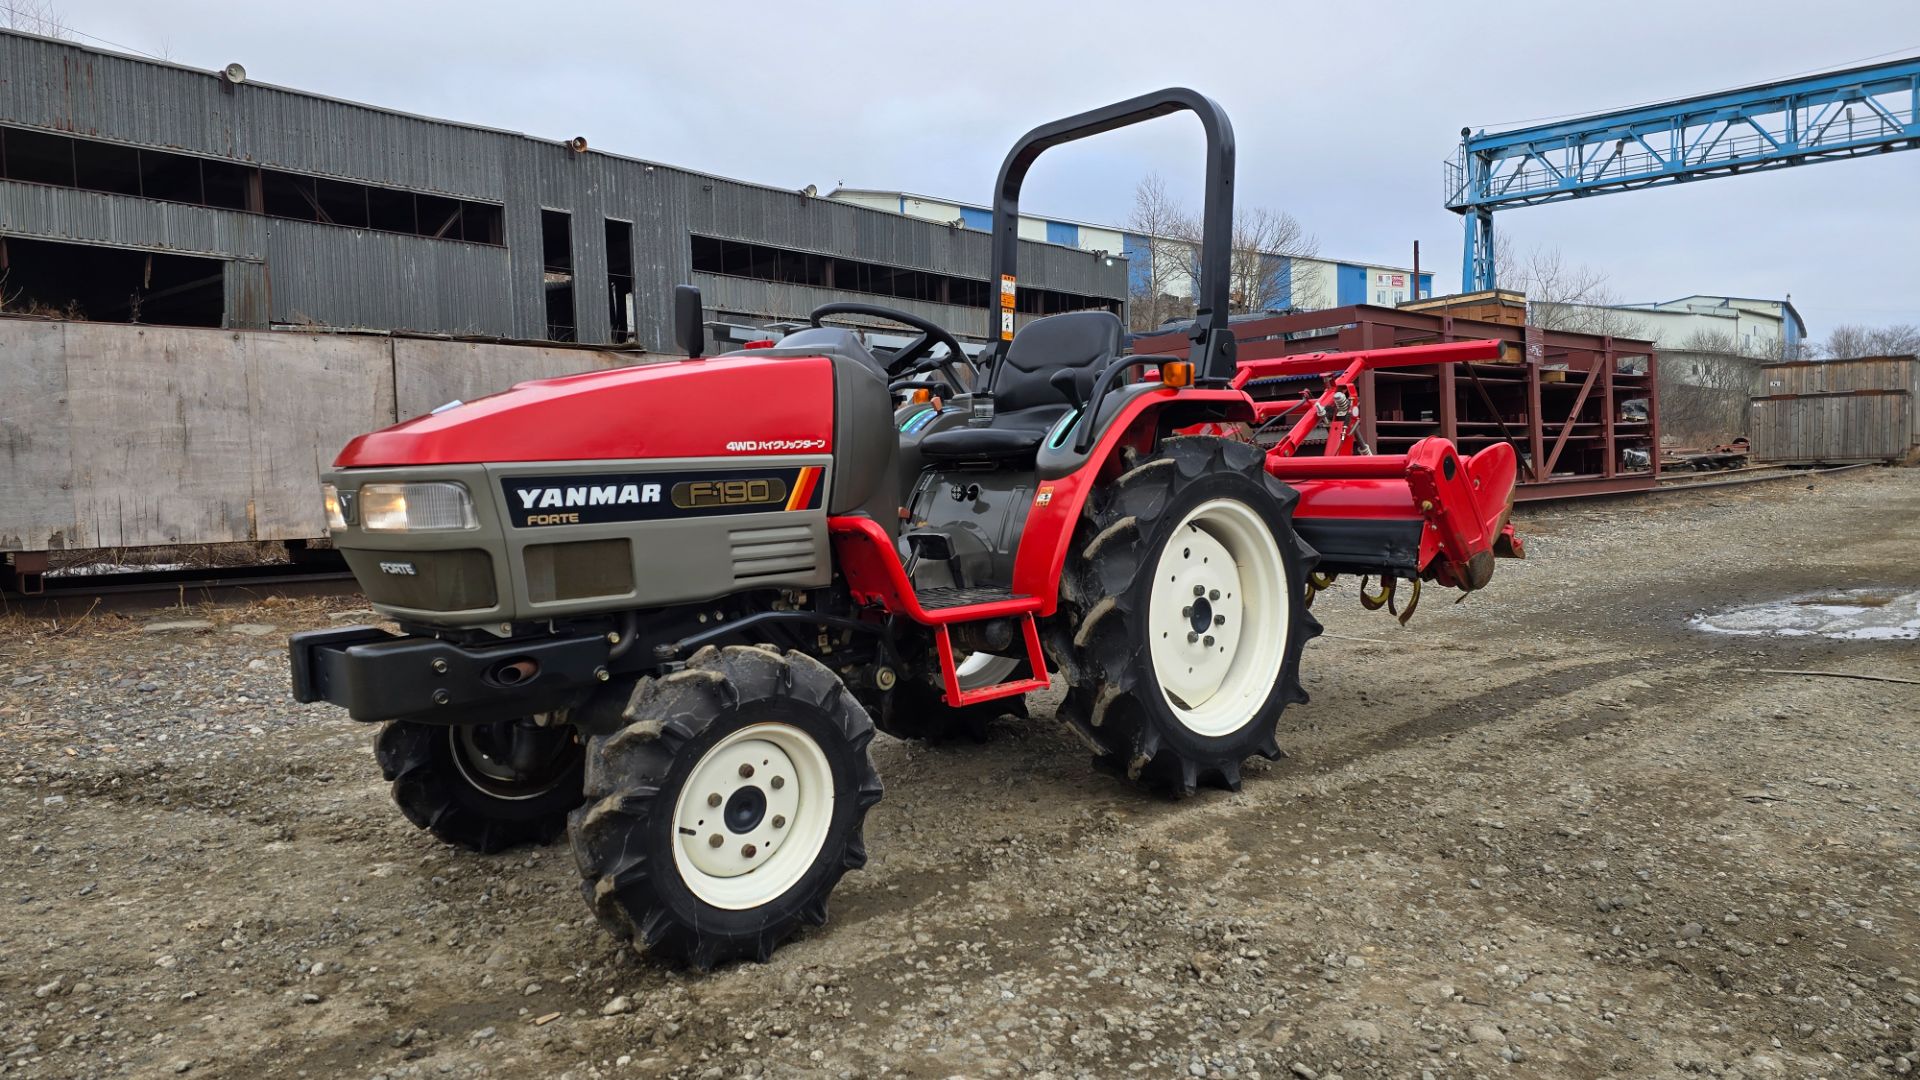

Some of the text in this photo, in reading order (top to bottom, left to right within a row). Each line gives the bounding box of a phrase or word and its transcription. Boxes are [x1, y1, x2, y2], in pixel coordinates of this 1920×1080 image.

[726, 441, 757, 451] 4WD
[517, 484, 661, 509] YANMAR
[527, 513, 579, 525] FORTE
[380, 562, 415, 575] FORTE
